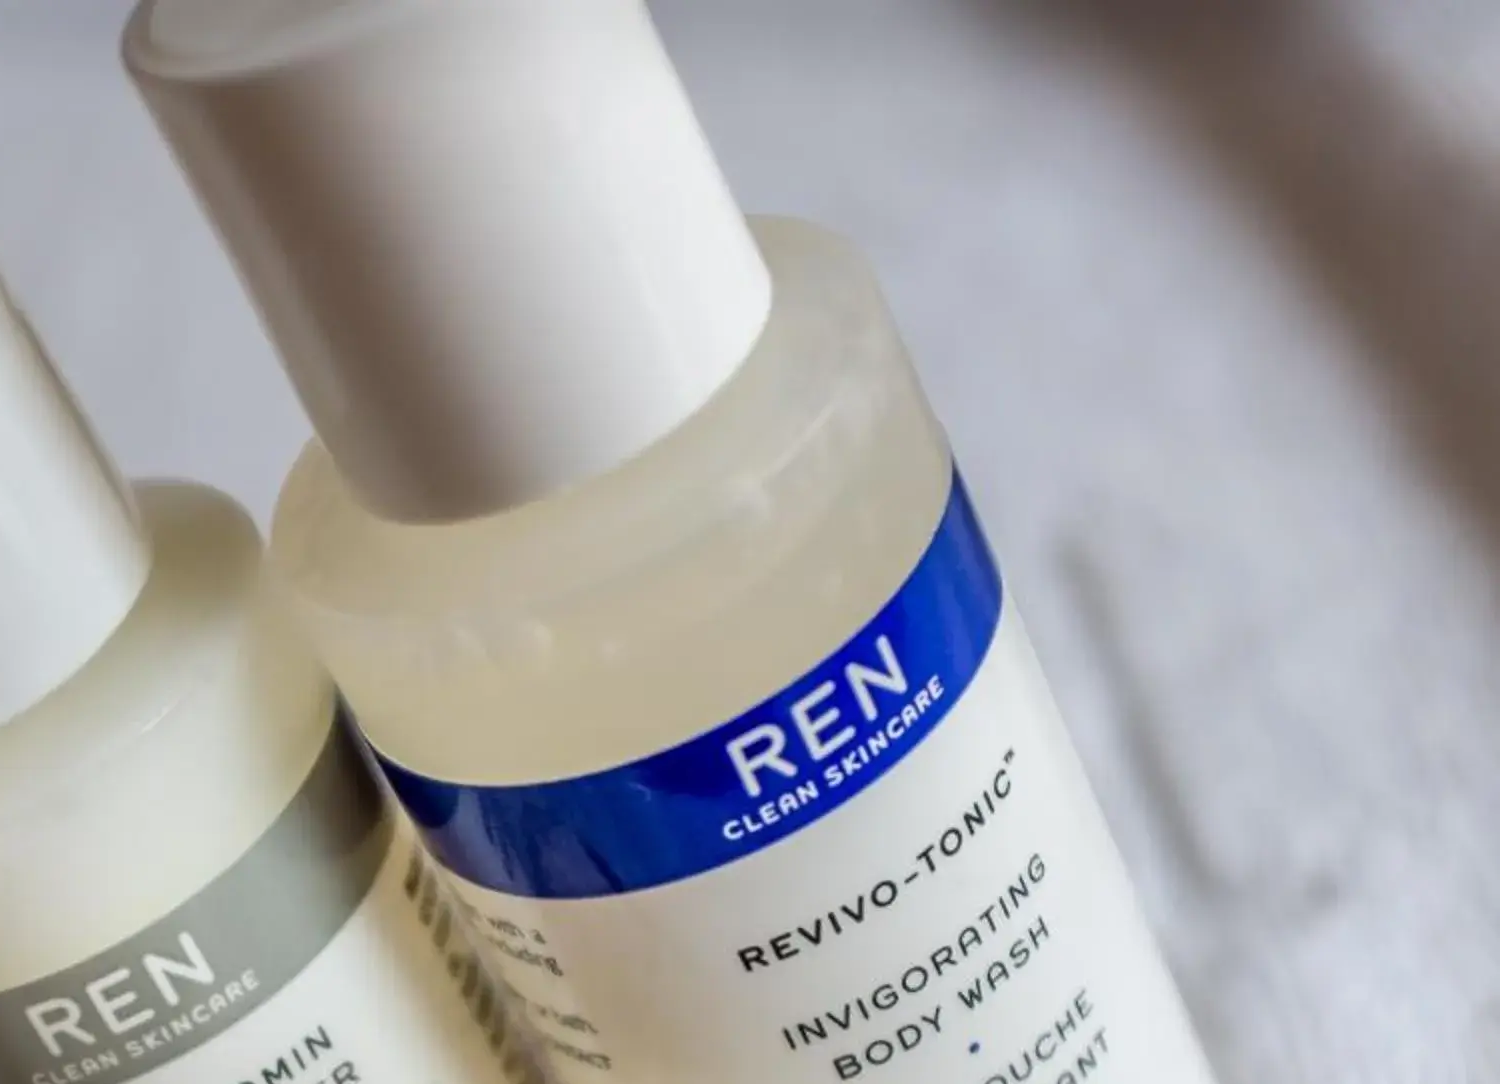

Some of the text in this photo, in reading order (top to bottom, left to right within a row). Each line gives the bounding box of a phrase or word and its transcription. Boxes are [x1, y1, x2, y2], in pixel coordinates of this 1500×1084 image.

[722, 673, 945, 841] CLEAN SKINCARE
[726, 634, 908, 798] REN
[25, 931, 215, 1057] REN
[124, 969, 261, 1059] SKINCARE
[783, 853, 1046, 1051] INVIGORATING
[832, 914, 1050, 1081] BODY WASH
